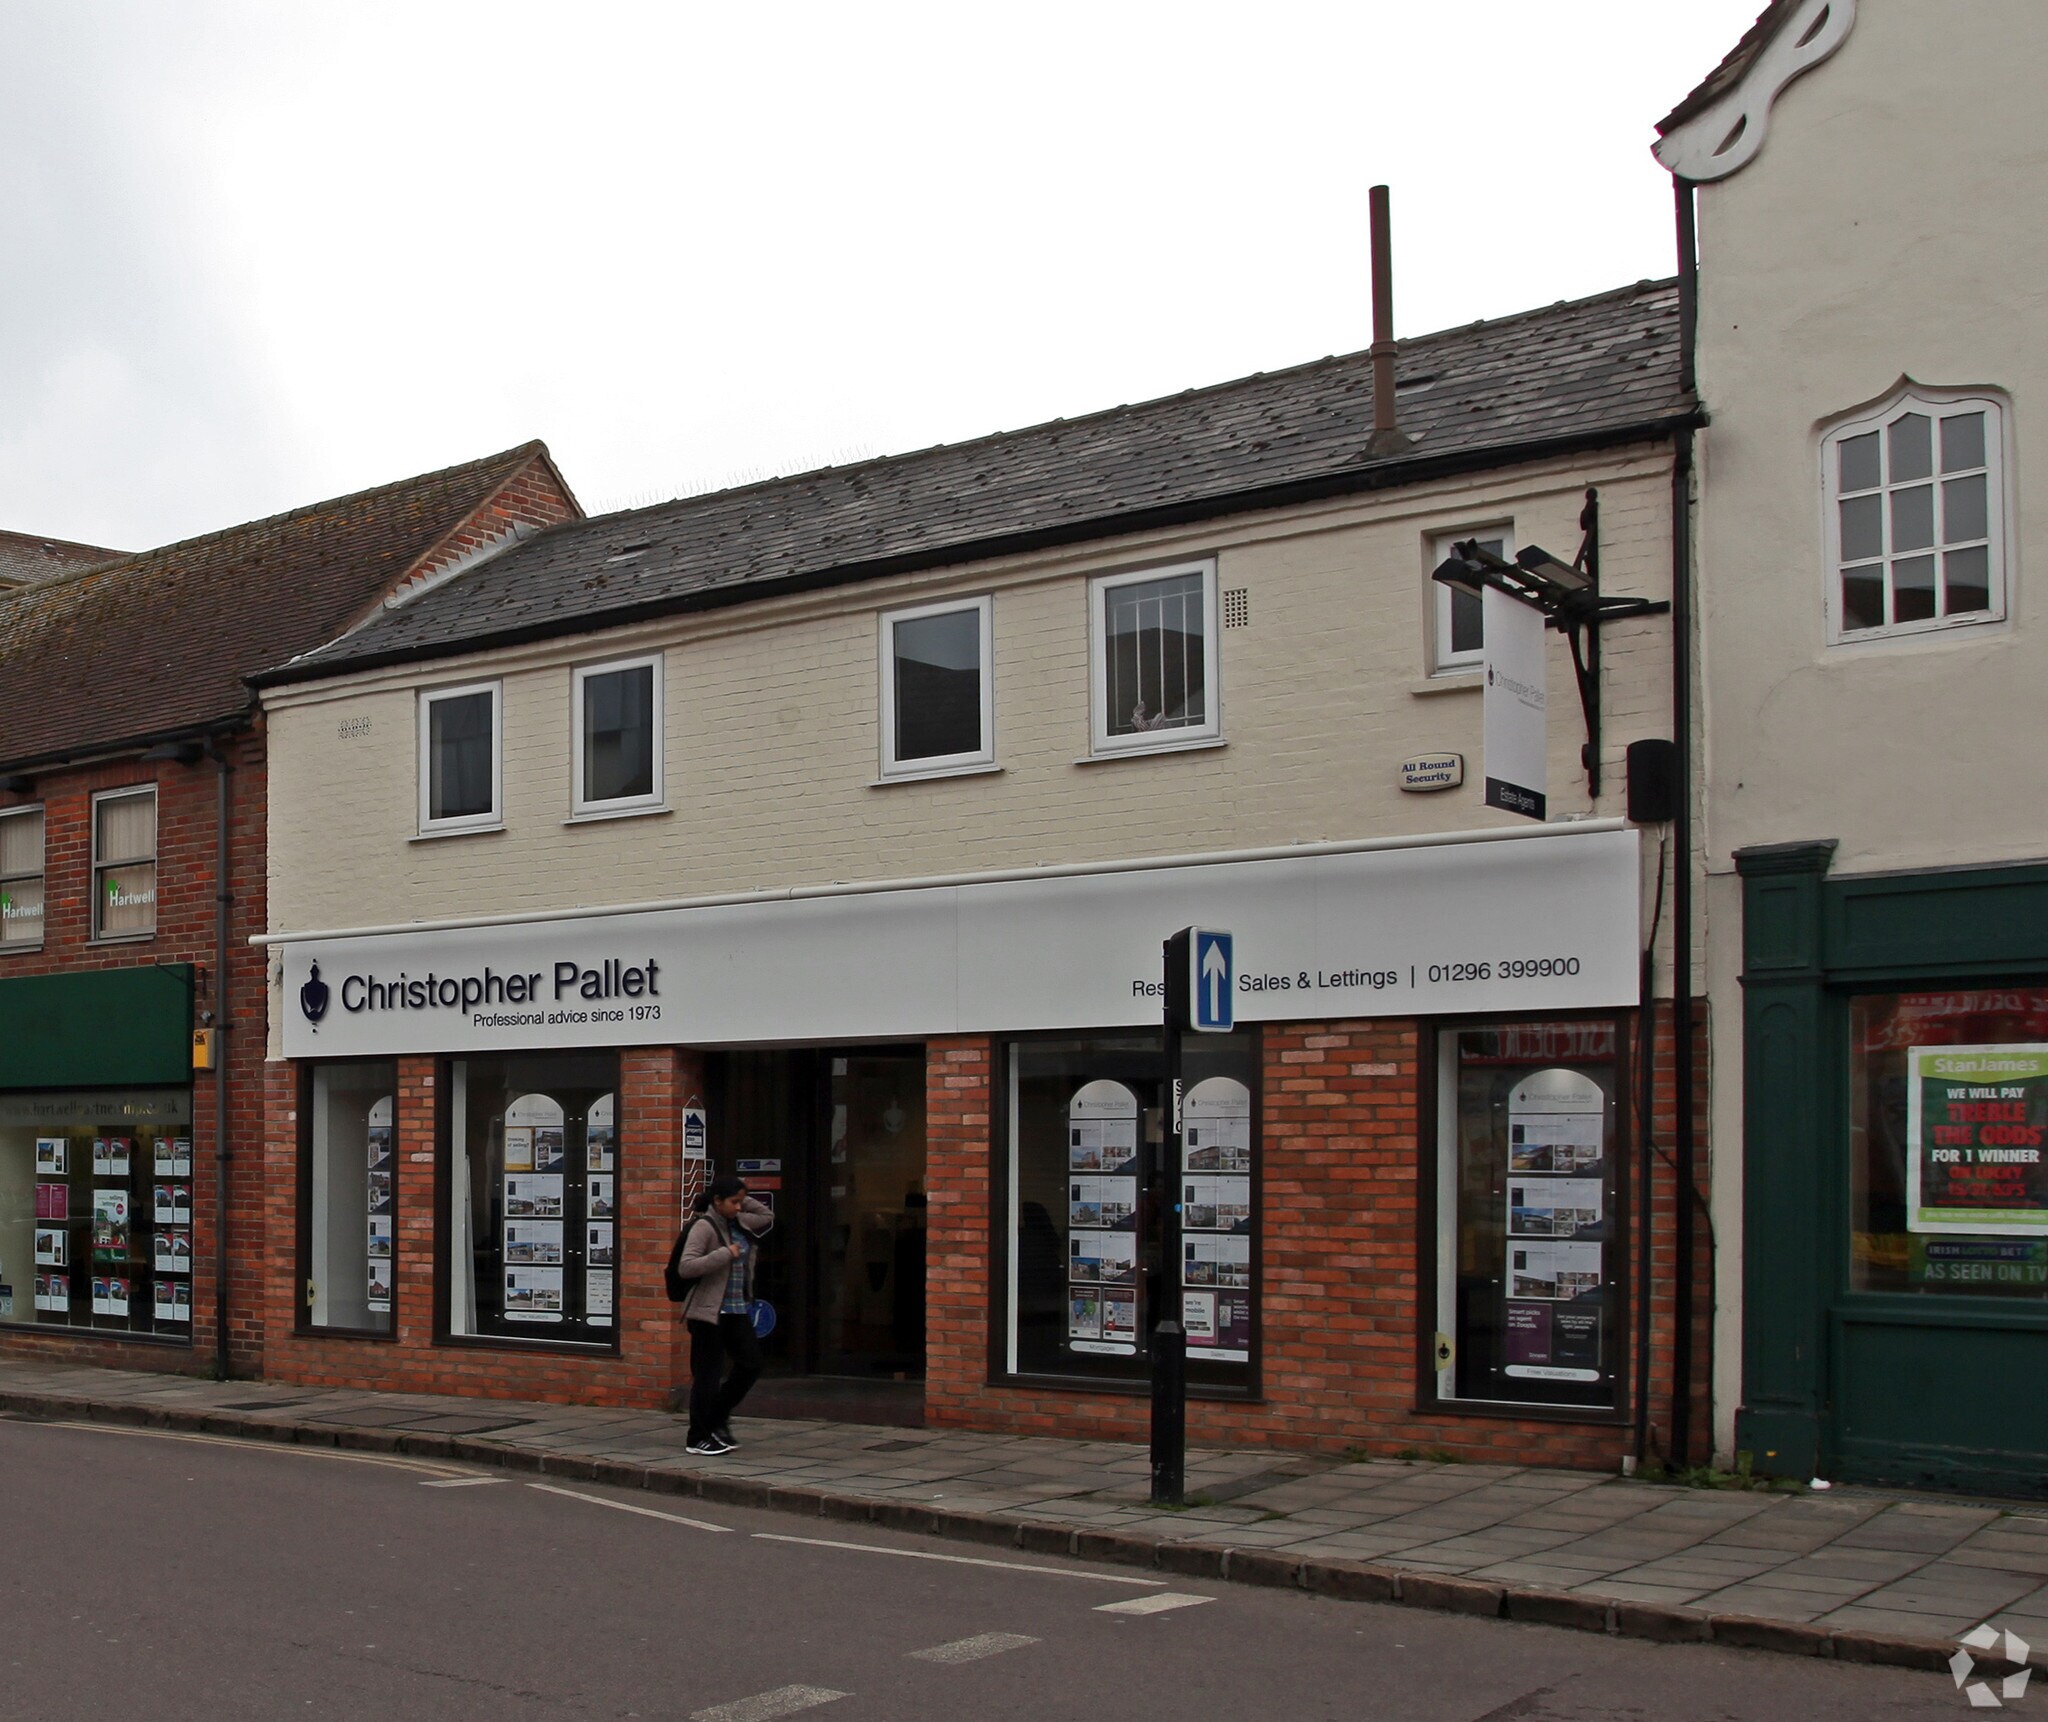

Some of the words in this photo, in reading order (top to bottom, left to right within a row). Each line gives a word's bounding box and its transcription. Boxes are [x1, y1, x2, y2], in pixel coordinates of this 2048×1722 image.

[1402, 763, 1416, 772] All
[1419, 760, 1456, 770] Round
[1406, 772, 1451, 783] Security
[1500, 787, 1517, 805] Estate
[110, 890, 154, 907] Hartwell
[3, 902, 43, 919] Hartwell
[1239, 973, 1291, 992] Sales
[1297, 971, 1312, 989] &
[1318, 969, 1398, 990] Lettings
[1428, 962, 1491, 982] 01296
[1497, 957, 1580, 979] 399900
[341, 966, 542, 1015] Christopher
[554, 958, 660, 1000] Pallet
[473, 1011, 544, 1027] Professional
[548, 1009, 588, 1024] advice
[591, 1008, 624, 1021] since
[628, 1006, 661, 1020] 1973
[1934, 1058, 2039, 1072] StanJames
[1947, 1088, 1966, 1099] WE
[1968, 1088, 1997, 1099] WILL
[2001, 1087, 2025, 1099] PAY
[1947, 1102, 2026, 1122] TREBLE
[1932, 1125, 1973, 1145] THE
[1932, 1149, 1960, 1162] FOR
[1965, 1149, 1972, 1162] 1
[1978, 1149, 2040, 1163] WINNER
[1928, 1245, 1960, 1255] IRISH
[2001, 1247, 2022, 1256] BET
[1925, 1263, 1946, 1279] AS
[1950, 1264, 1993, 1280] SEEN
[1998, 1265, 2020, 1281] ON
[2027, 1265, 2048, 1281] TV
